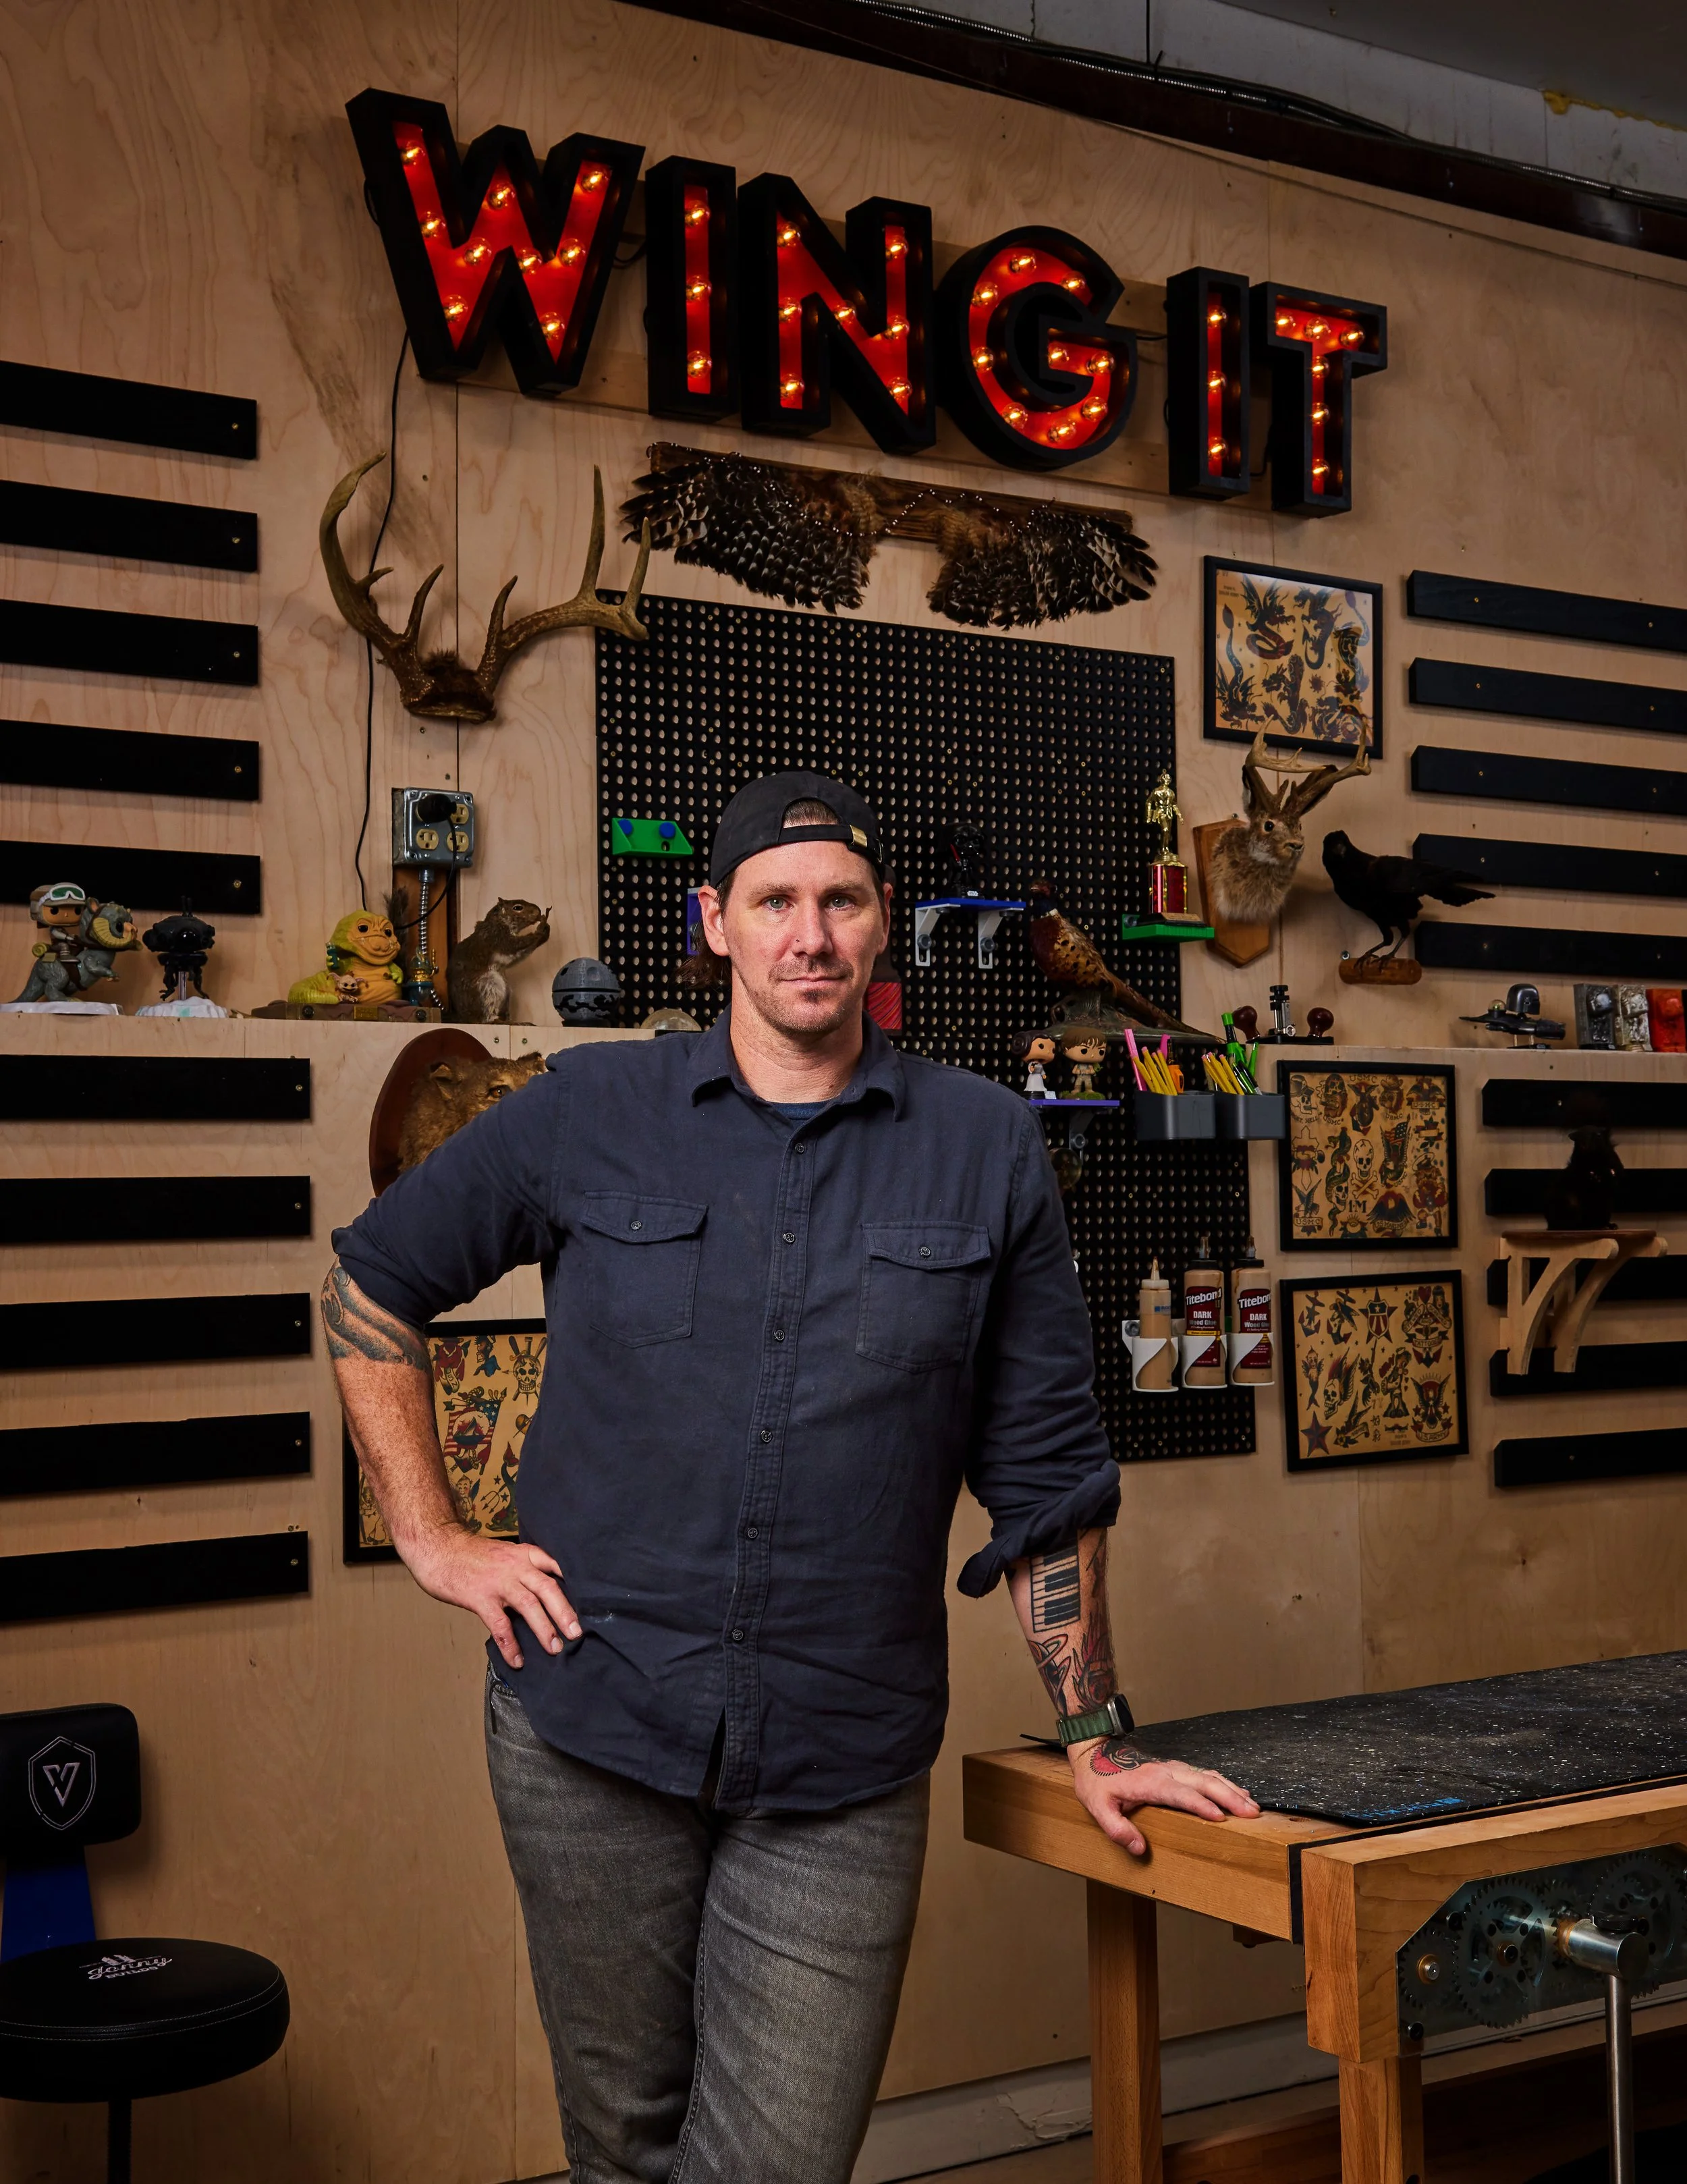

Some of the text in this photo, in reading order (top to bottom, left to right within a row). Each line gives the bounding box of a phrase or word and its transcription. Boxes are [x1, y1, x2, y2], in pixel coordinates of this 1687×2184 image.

[345, 88, 1387, 518] WING IT
[1349, 1074, 1377, 1084] USMC
[1186, 1287, 1222, 1306] Titebond
[1238, 1293, 1271, 1309] Titebon
[1193, 1311, 1212, 1319] DARK
[1250, 1313, 1267, 1321] DARK
[445, 1367, 458, 1388] USN
